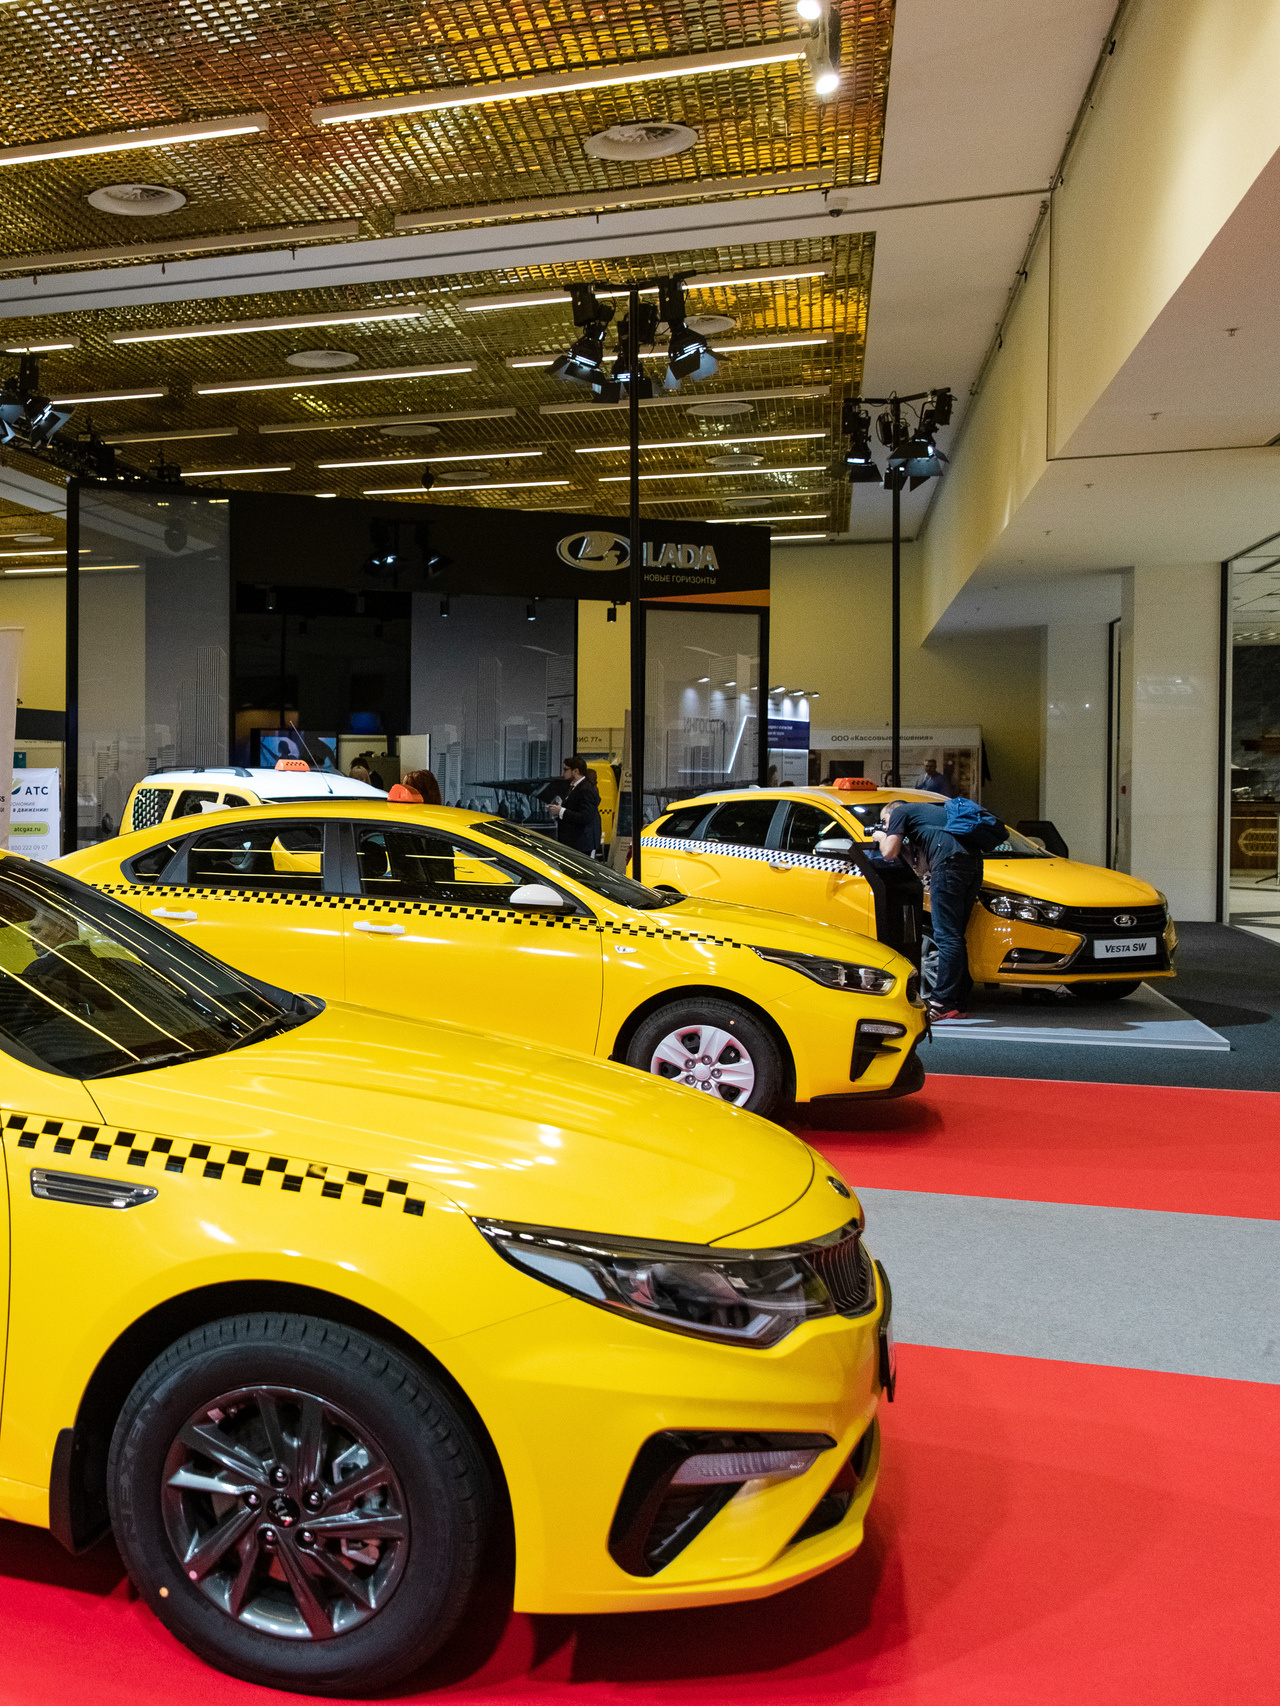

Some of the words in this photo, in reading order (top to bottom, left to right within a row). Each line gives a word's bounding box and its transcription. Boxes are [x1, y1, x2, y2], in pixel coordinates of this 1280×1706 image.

[642, 541, 720, 571] LADA
[643, 573, 671, 583] НОВЫЕ
[671, 575, 717, 585] ГОРИЗОНТЫ
[13, 825, 41, 833] atcgaz.ru
[1104, 944, 1131, 954] VESTA
[1132, 942, 1148, 952] SW
